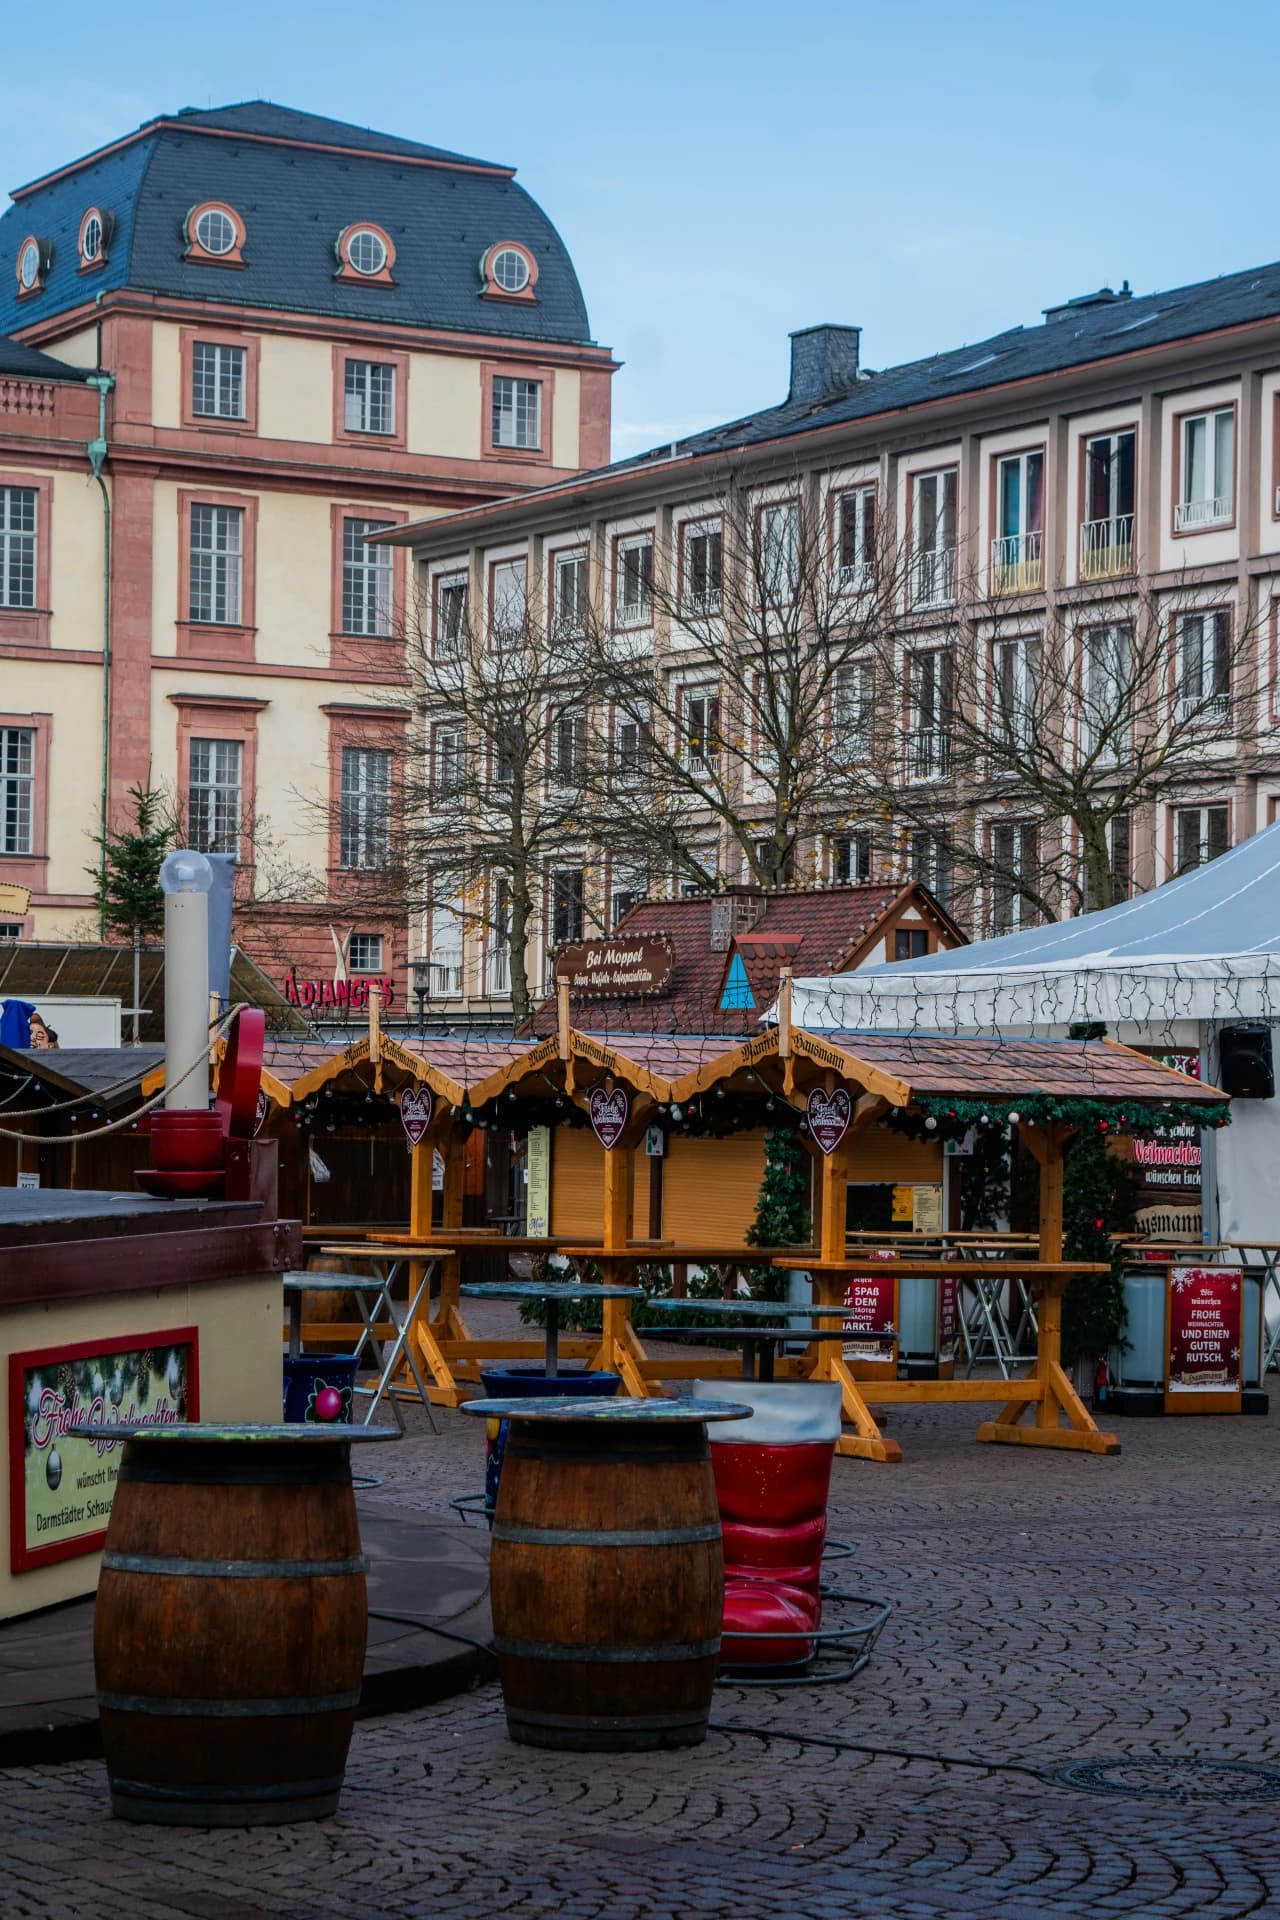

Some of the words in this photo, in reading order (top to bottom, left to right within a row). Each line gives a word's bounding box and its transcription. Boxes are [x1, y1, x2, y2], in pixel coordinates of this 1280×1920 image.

[587, 950, 602, 968] Bei
[603, 946, 644, 967] Moppel
[1145, 1169, 1182, 1185] wünschen
[1183, 1169, 1201, 1185] Euch
[855, 1298, 877, 1306] DEM
[1191, 1310, 1221, 1319] FROHE
[1181, 1330, 1202, 1339] UND
[1203, 1330, 1230, 1339] EINEN
[1190, 1341, 1221, 1351] GUTEN
[1186, 1353, 1224, 1362] RUTSCH.
[32, 1387, 86, 1450] Frohe
[76, 1468, 106, 1489] wünscht
[36, 1504, 84, 1532] Darmstädter
